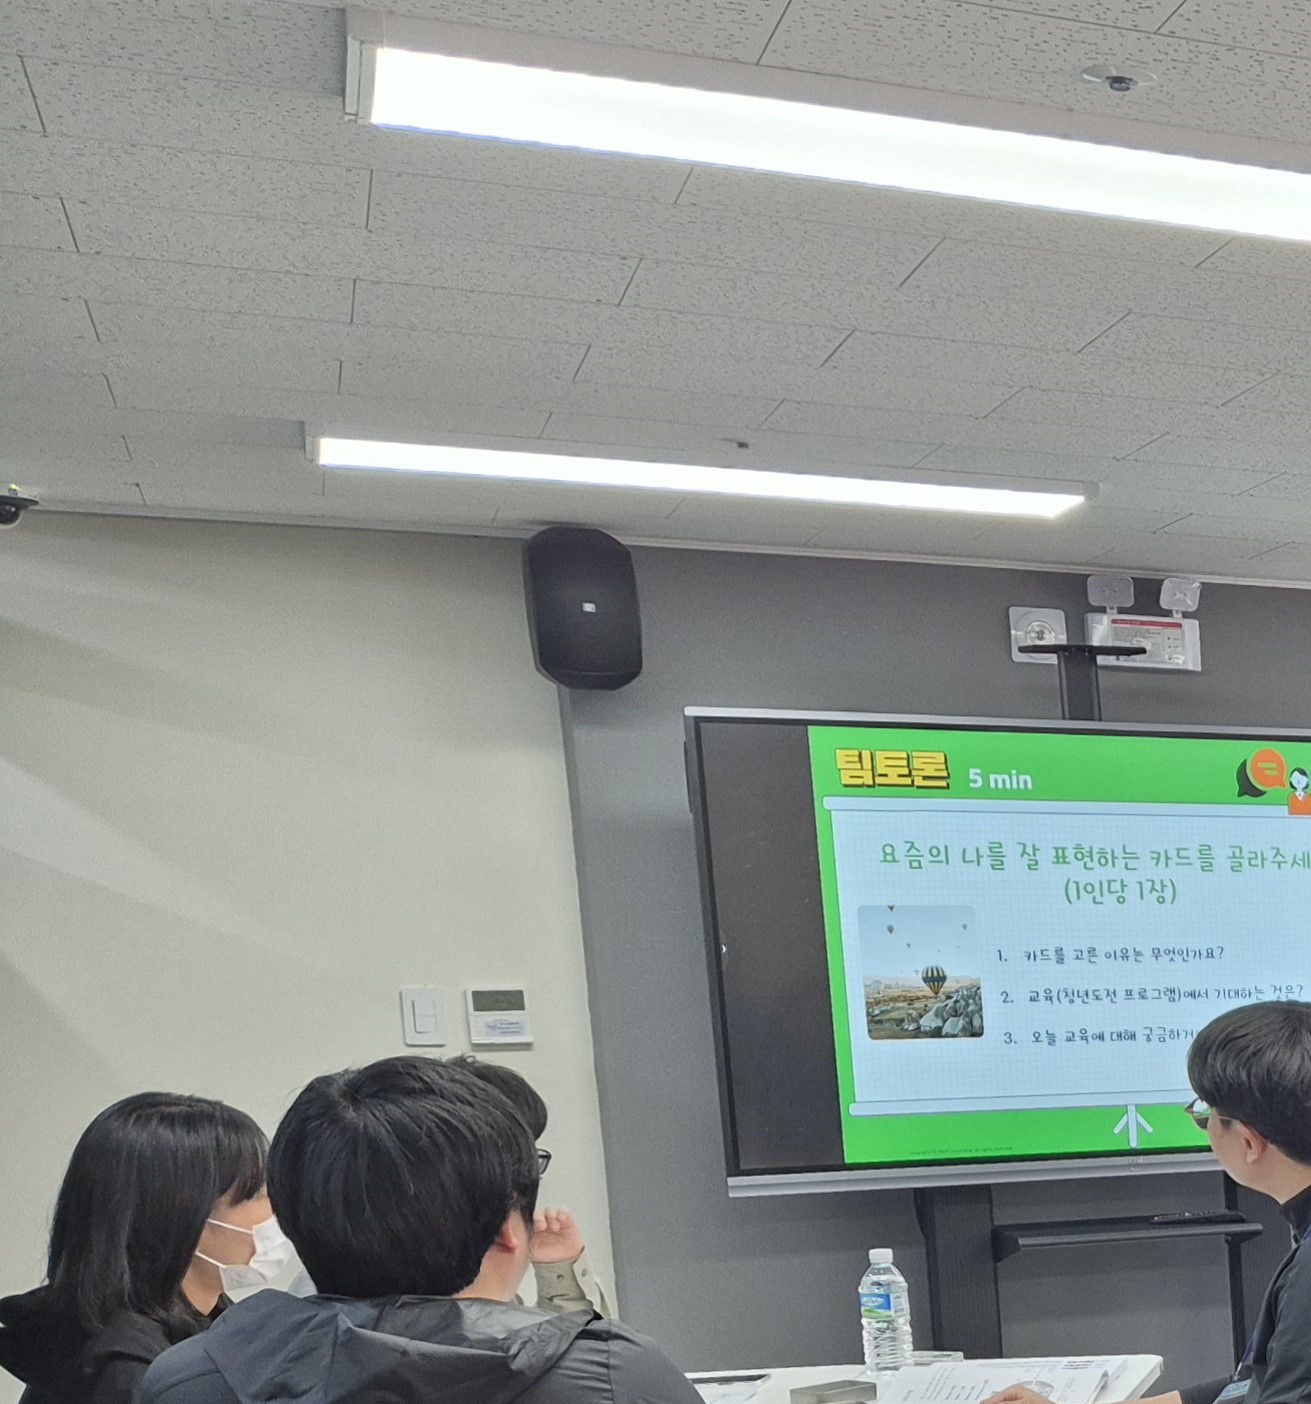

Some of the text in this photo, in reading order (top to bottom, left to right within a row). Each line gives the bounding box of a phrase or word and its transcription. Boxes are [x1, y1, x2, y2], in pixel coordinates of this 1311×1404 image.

[835, 748, 950, 789] 팀토론
[968, 768, 1033, 790] 5 min
[880, 840, 950, 870] 요즘의
[962, 841, 1006, 871] 나를
[1016, 842, 1040, 871] 잘
[1051, 843, 1140, 872] 표현하는
[1150, 844, 1215, 873] 카드를
[1064, 878, 1177, 905] (1인당 1장)
[997, 946, 1224, 965] 1. 카드를 고른 이유는 무엇인가요?
[1000, 991, 1014, 1004] 2.
[1124, 986, 1209, 1003] 프로그램)에서
[1214, 985, 1265, 1001] 기대하는
[1003, 1026, 1199, 1046] 3. 오늘 교육에 대해 궁금하거
